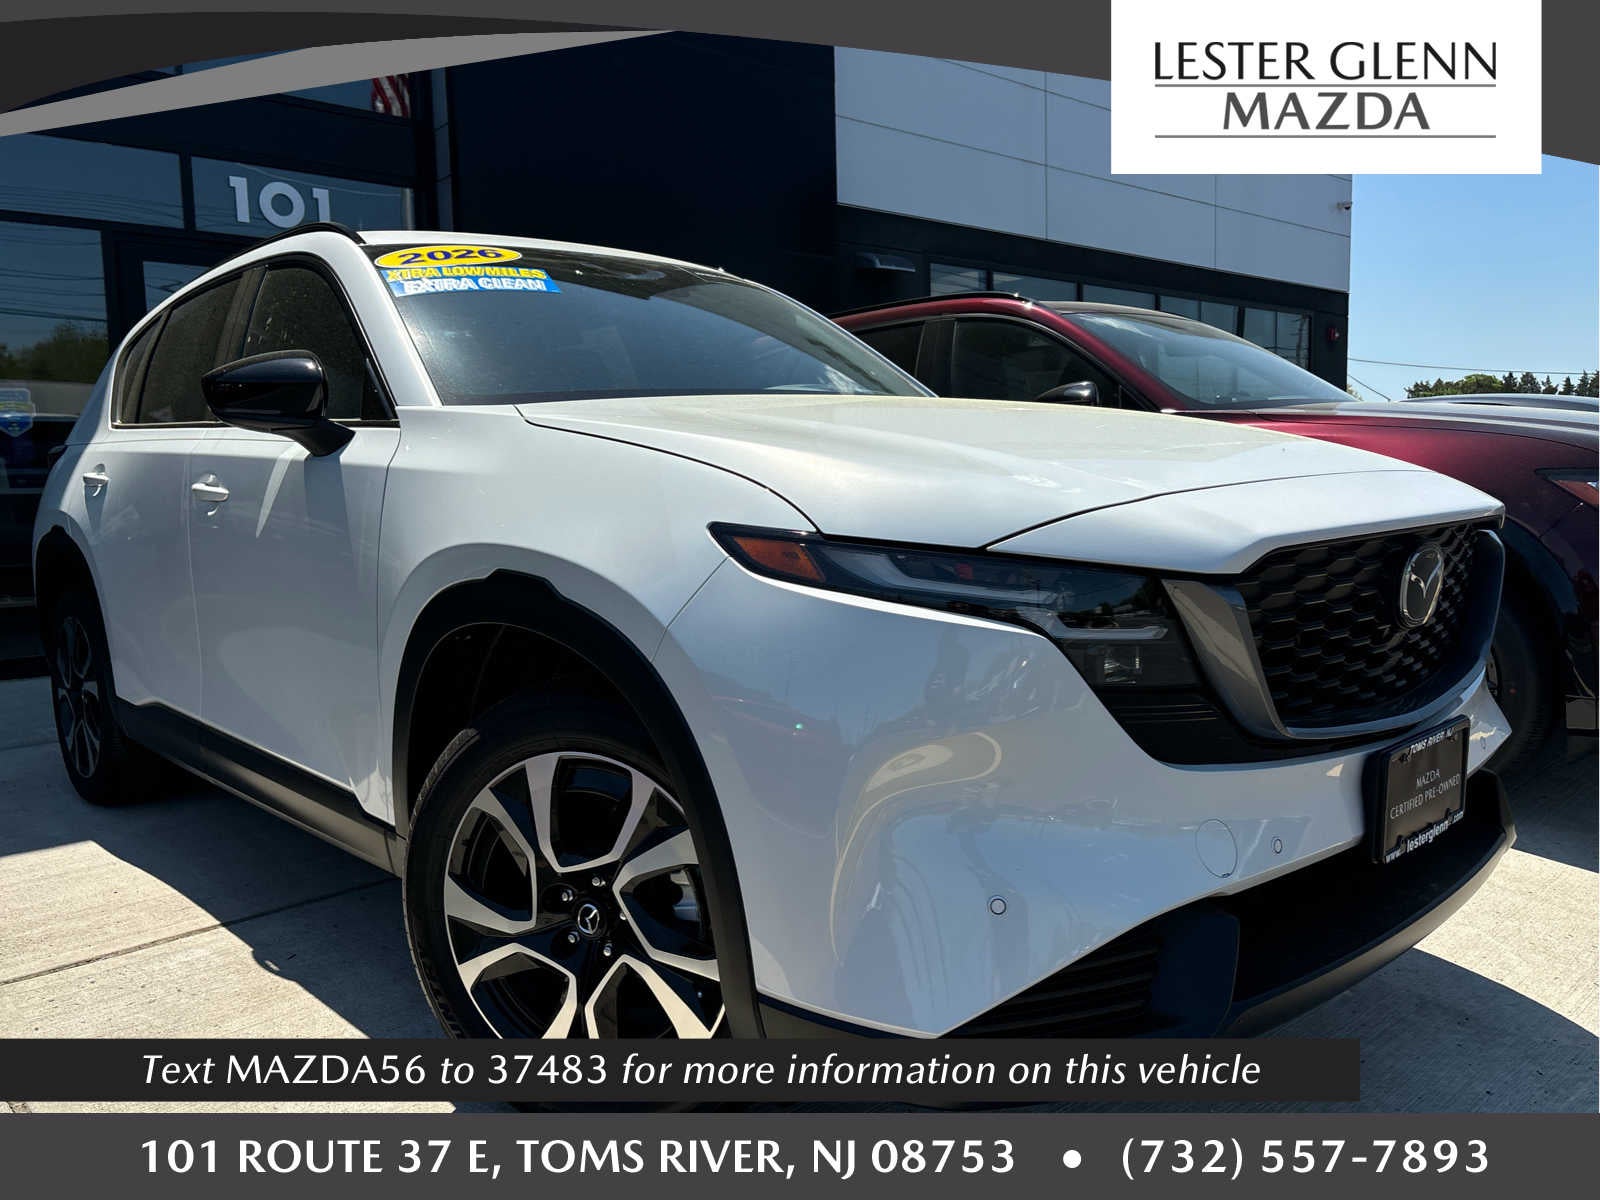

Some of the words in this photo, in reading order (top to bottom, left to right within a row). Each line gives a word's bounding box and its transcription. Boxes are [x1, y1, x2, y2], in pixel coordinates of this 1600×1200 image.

[228, 175, 331, 229] 101
[400, 249, 503, 265] 2026
[386, 267, 440, 282] XTRA
[482, 268, 547, 280] MILES
[401, 277, 475, 294] EXTRA
[477, 277, 547, 291] CLEAN
[1409, 738, 1428, 755] TOMS
[1416, 768, 1441, 788] MAZDA
[1390, 793, 1423, 819] CERTIFIED
[1424, 773, 1461, 803] PRE-OWNED
